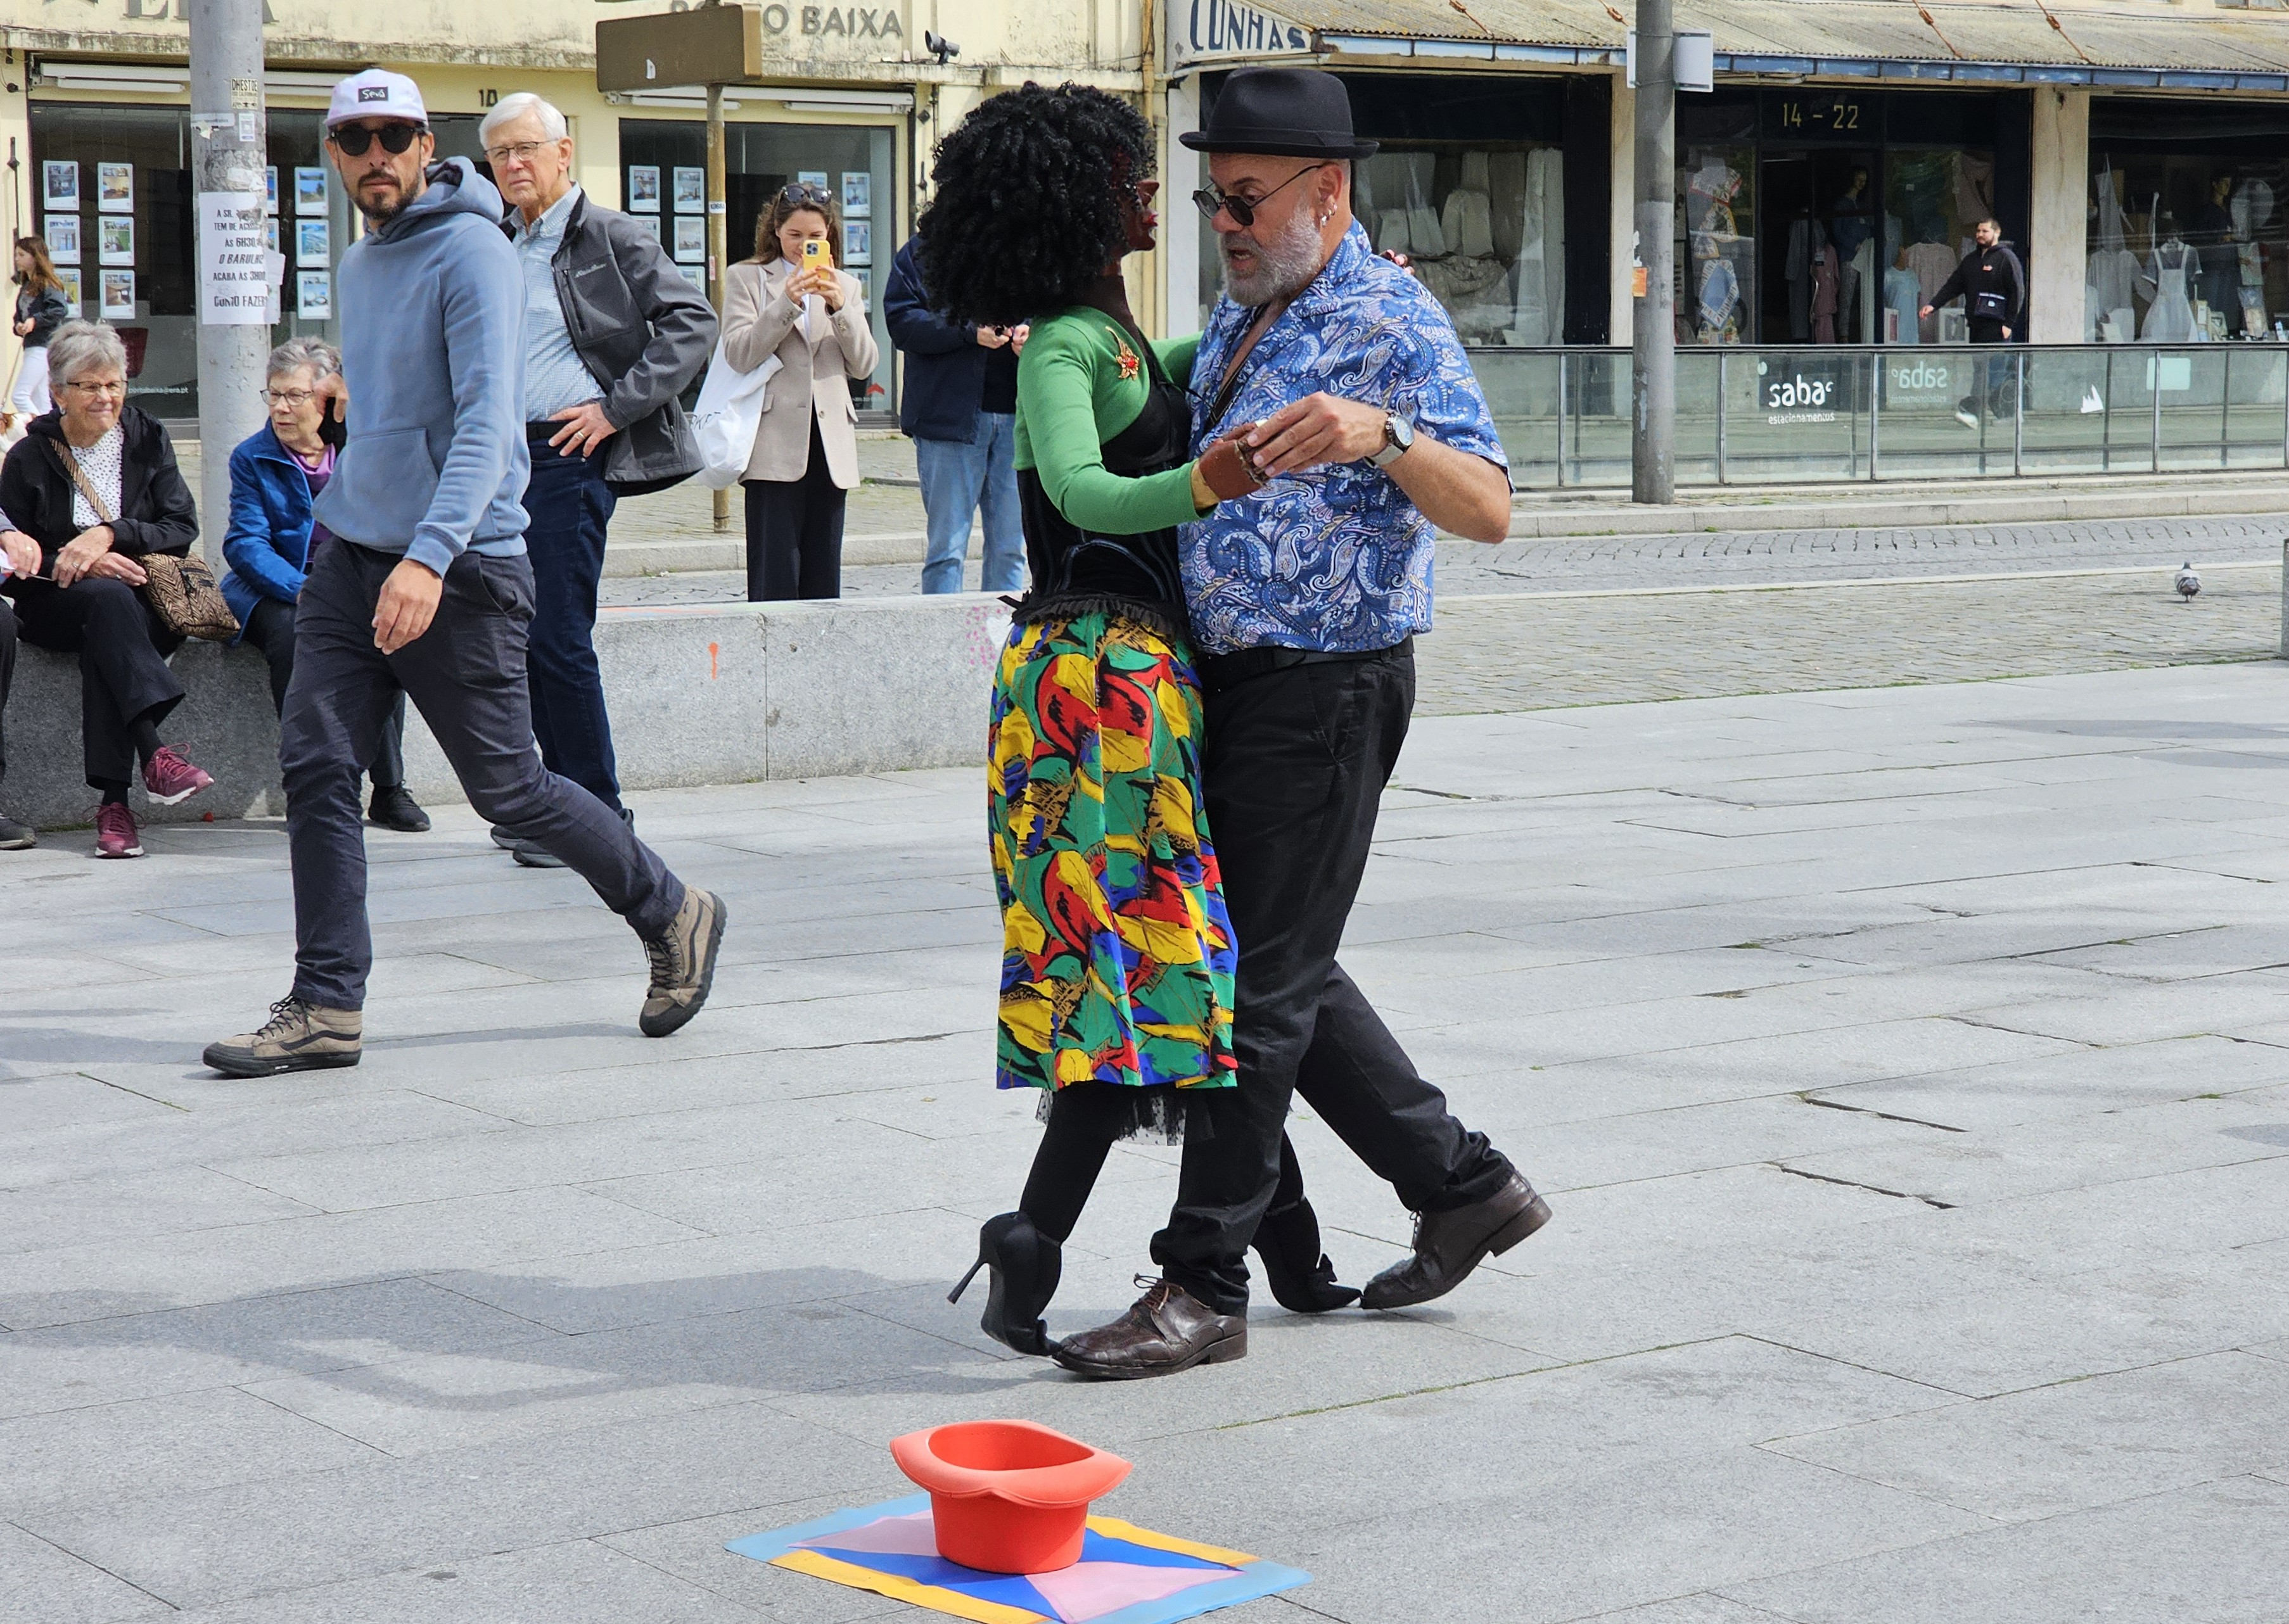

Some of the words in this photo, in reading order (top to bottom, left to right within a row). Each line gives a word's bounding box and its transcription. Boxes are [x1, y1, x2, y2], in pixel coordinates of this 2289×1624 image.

[801, 6, 903, 37] BAIXA
[1190, 0, 1306, 51] CUNHAS
[1783, 103, 1802, 127] 14
[1833, 105, 1858, 129] 22
[214, 222, 227, 231] TEM
[229, 222, 237, 231] DE
[219, 254, 226, 264] O
[213, 272, 237, 281] ACABA
